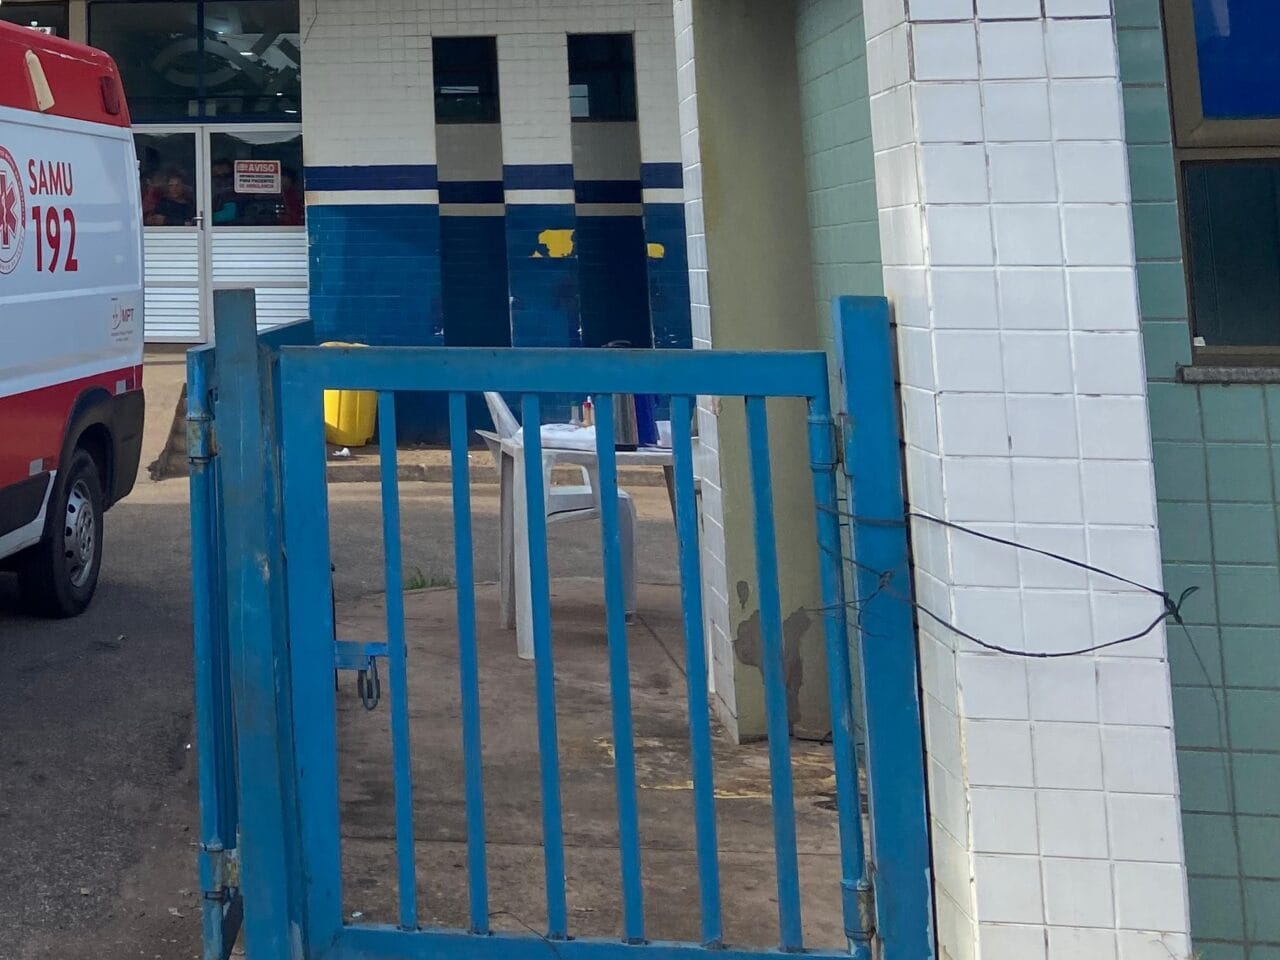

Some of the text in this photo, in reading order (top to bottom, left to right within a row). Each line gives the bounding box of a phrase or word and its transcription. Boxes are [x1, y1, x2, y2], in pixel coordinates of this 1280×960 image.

[28, 158, 73, 196] SAMU
[248, 163, 275, 172] AVISO
[32, 205, 78, 273] 192
